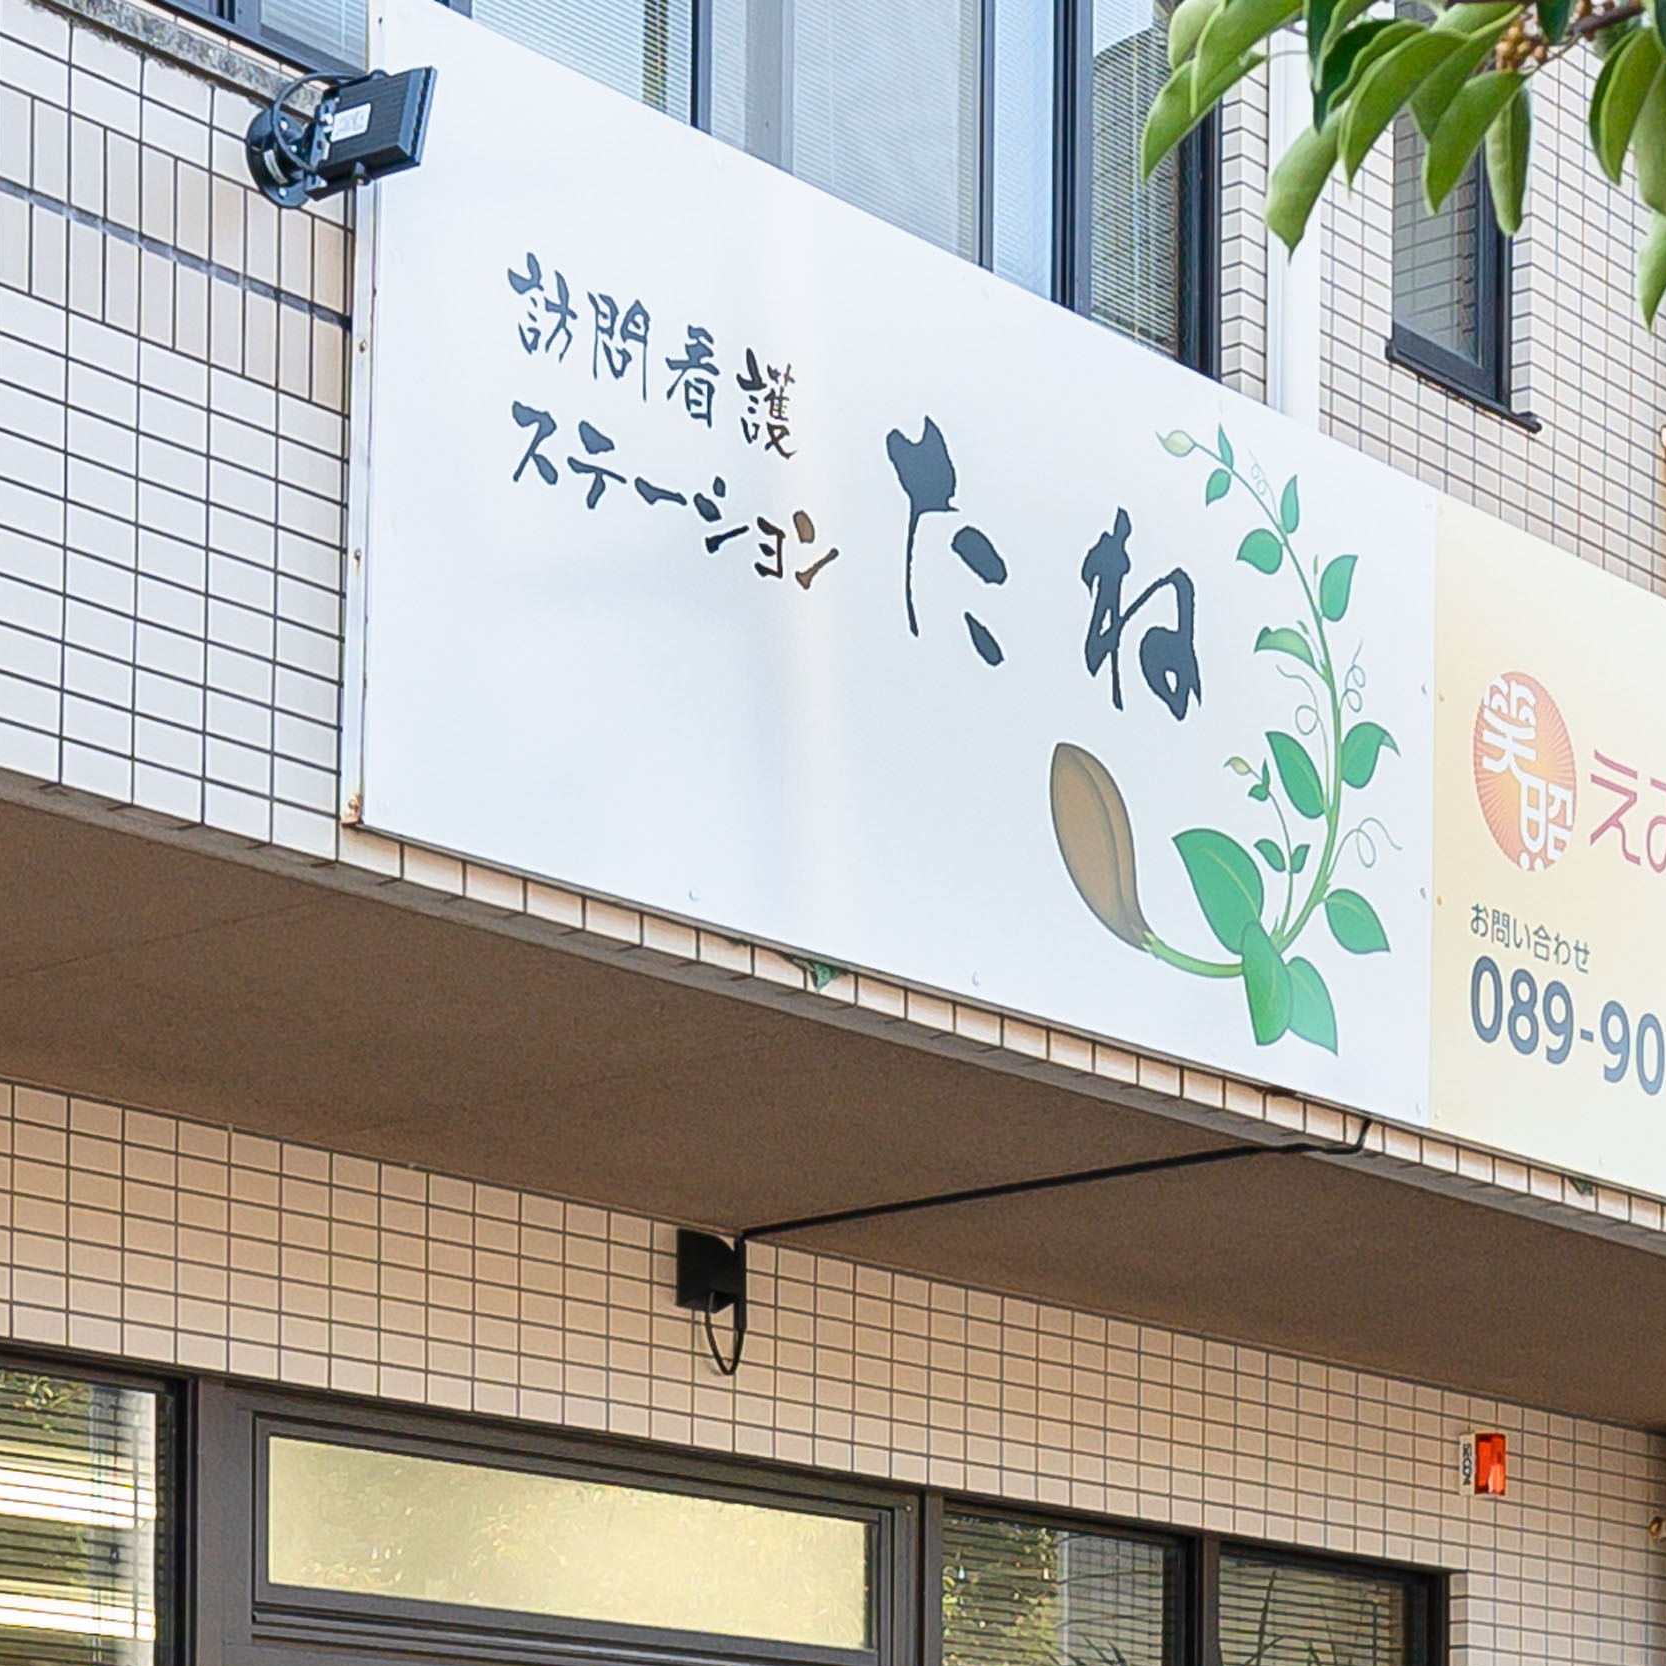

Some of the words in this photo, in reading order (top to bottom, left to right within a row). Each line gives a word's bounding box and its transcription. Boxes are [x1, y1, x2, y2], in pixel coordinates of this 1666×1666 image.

[507, 252, 798, 458] 訪問看護
[511, 401, 839, 591] ステーション
[884, 415, 1201, 722] たね
[1470, 902, 1591, 975] お問い合わせ
